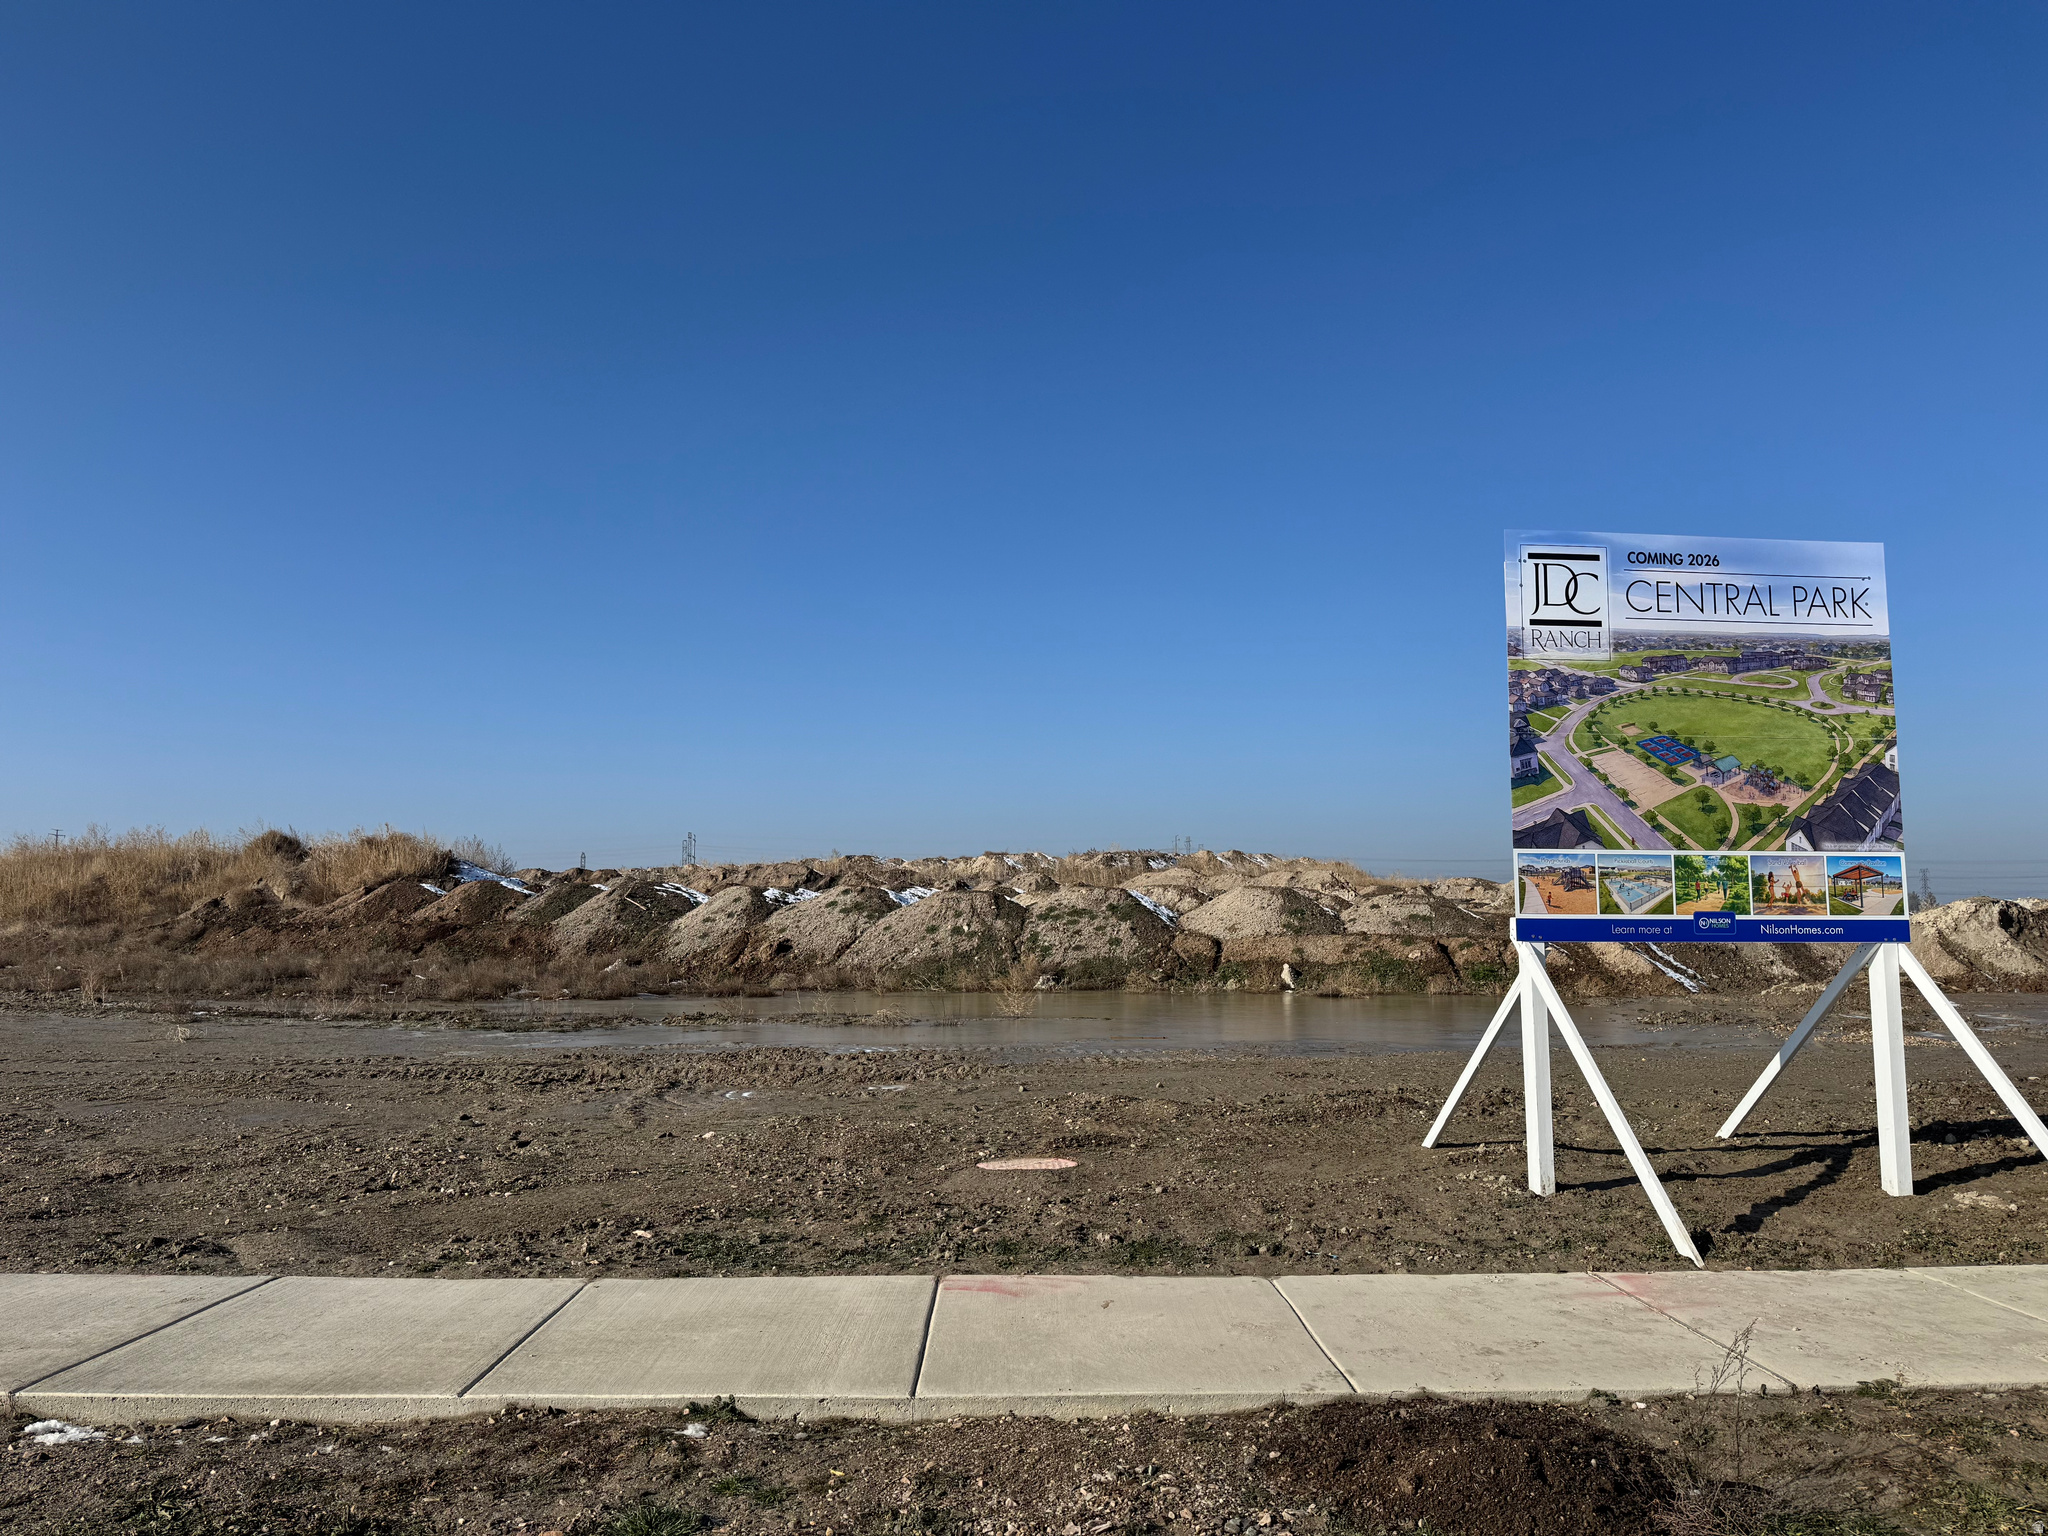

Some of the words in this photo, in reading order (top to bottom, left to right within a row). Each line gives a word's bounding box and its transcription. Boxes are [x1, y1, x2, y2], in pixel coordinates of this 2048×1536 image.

[1627, 551, 1683, 566] COMING
[1688, 554, 1720, 567] 2026
[1531, 563, 1600, 616] JDC
[1626, 580, 1780, 617] CENTRAL
[1793, 586, 1872, 619] PARK
[1531, 629, 1601, 652] RANCH
[1611, 924, 1636, 934] Learn
[1638, 926, 1661, 934] more
[1663, 926, 1672, 934] at
[1760, 924, 1844, 935] NilsonHomes.com
